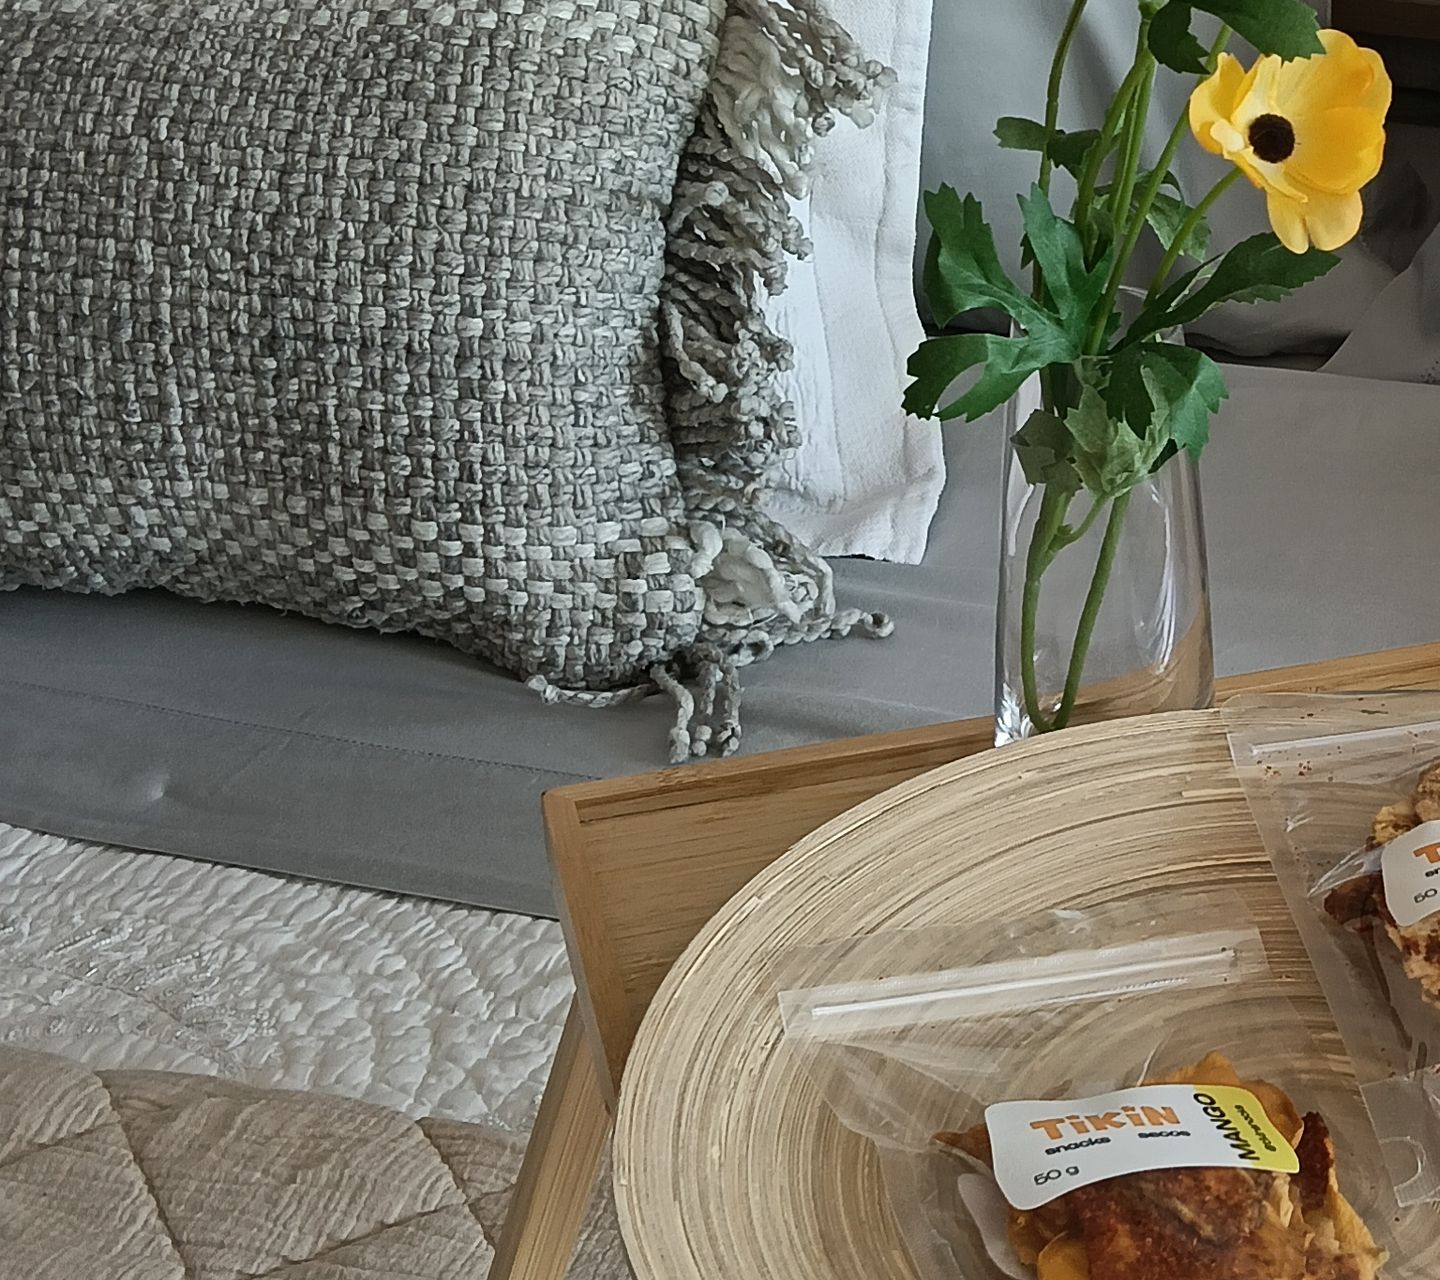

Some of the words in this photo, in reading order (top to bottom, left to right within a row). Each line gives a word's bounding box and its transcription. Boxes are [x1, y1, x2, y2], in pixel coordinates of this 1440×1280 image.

[1414, 888, 1438, 904] 50
[1193, 1093, 1260, 1160] MANGO
[1044, 1135, 1111, 1155] snacks
[1138, 1129, 1191, 1138] secos
[1033, 1169, 1061, 1186] 50
[1065, 1166, 1080, 1176] g
